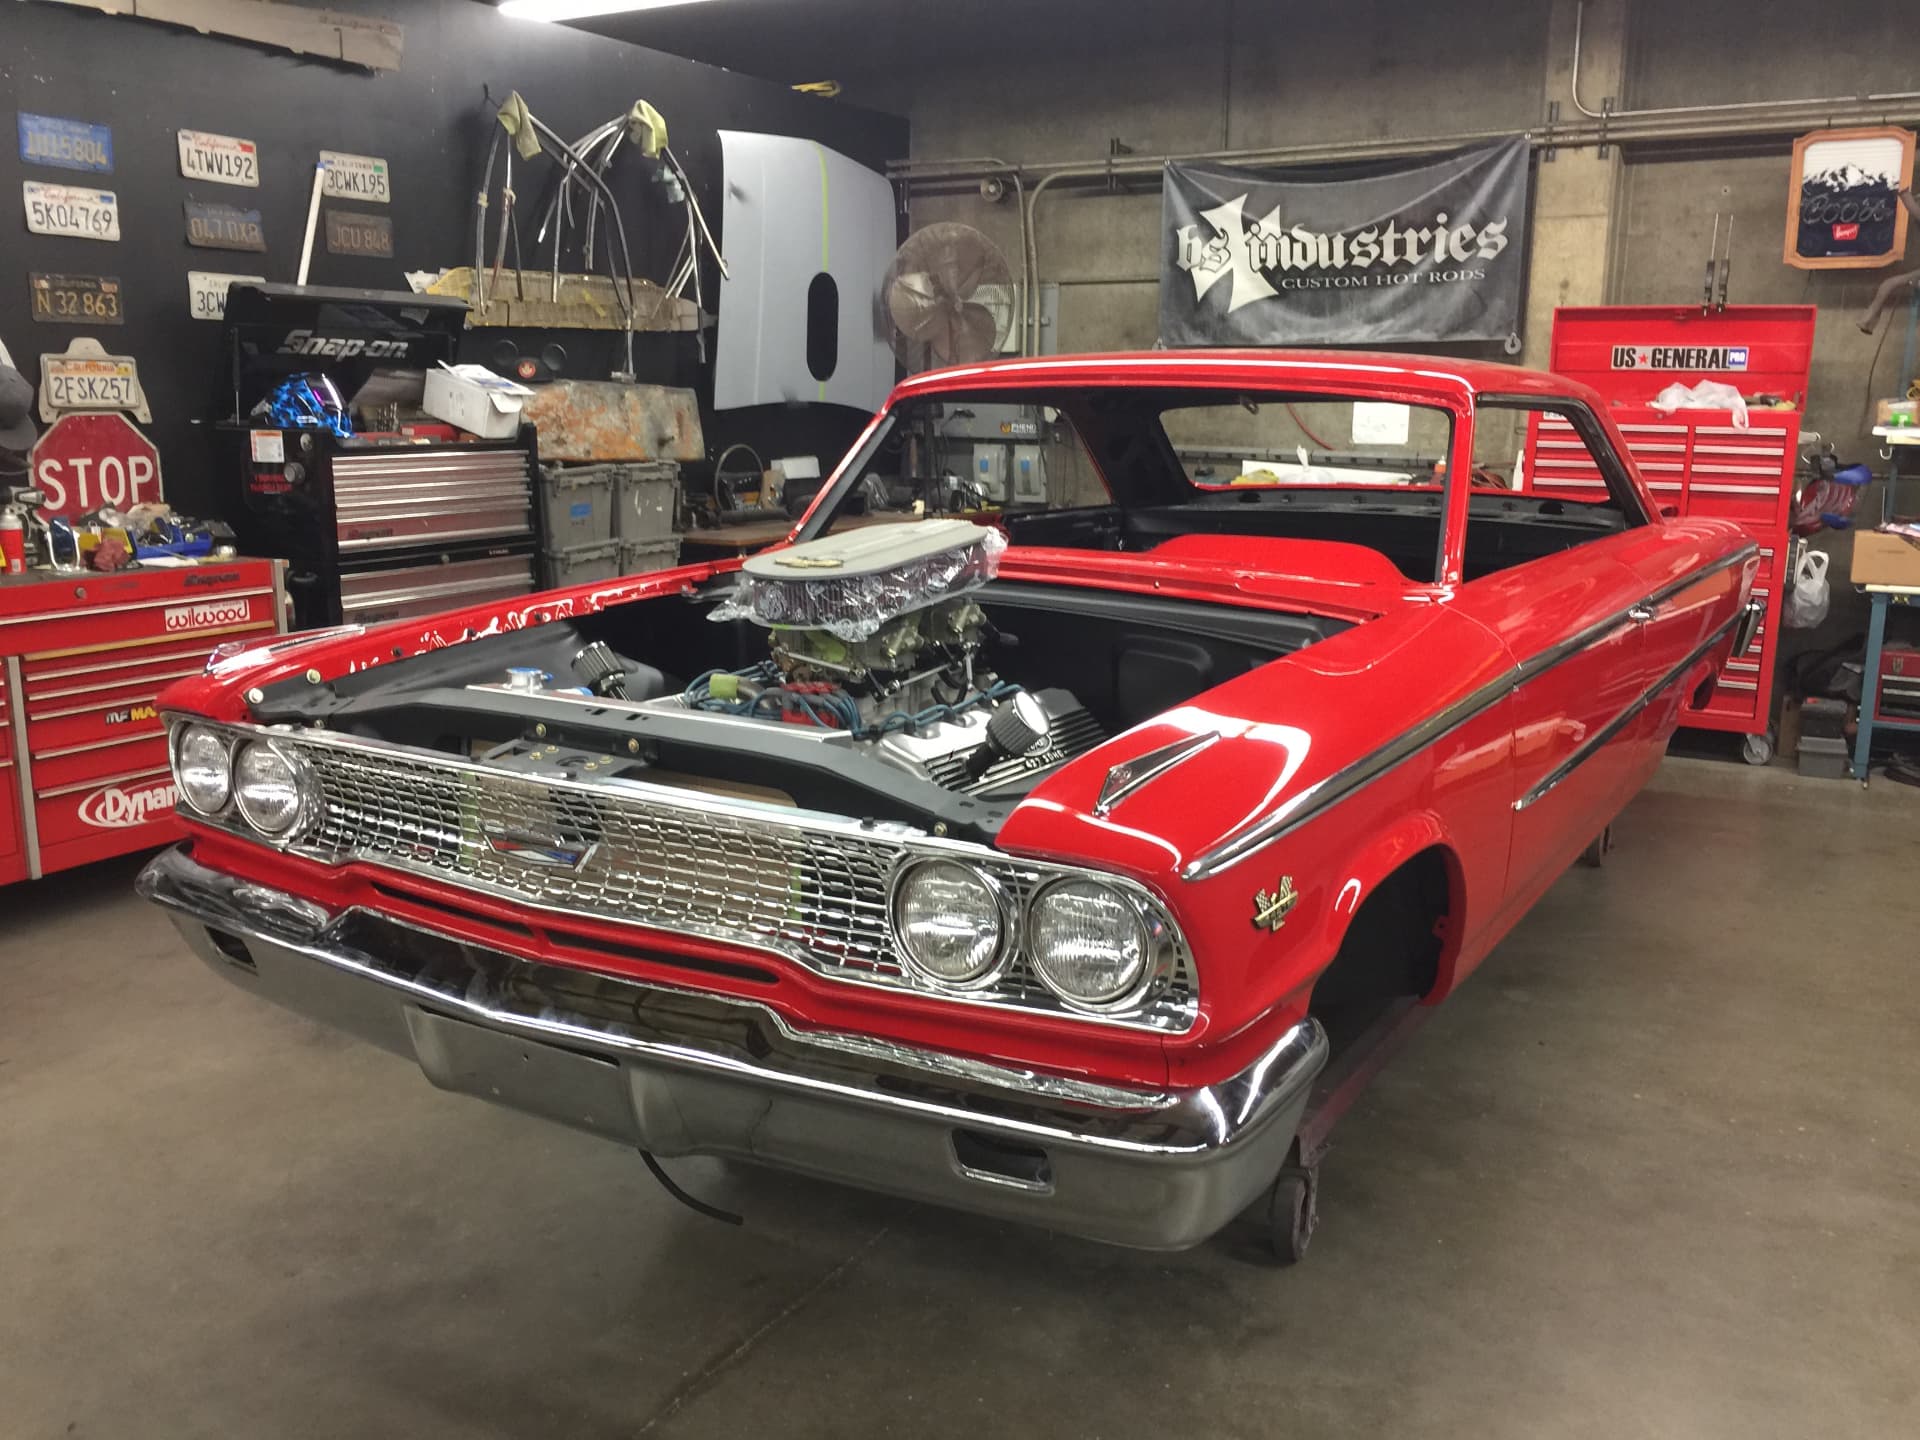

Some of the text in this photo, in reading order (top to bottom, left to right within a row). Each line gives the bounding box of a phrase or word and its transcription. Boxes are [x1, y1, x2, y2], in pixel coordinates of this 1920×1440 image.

[186, 147, 254, 180] 4TWV192
[327, 168, 386, 195] 3CWK195
[1244, 212, 1508, 273] industries
[1282, 268, 1485, 290] CUSTOM HOT RODS
[197, 290, 226, 313] 3CW
[277, 329, 408, 361] Snap-on
[1612, 347, 1637, 368] US
[1650, 347, 1731, 369] GENERAL
[39, 455, 154, 511] STOP
[167, 600, 247, 629] wilwood
